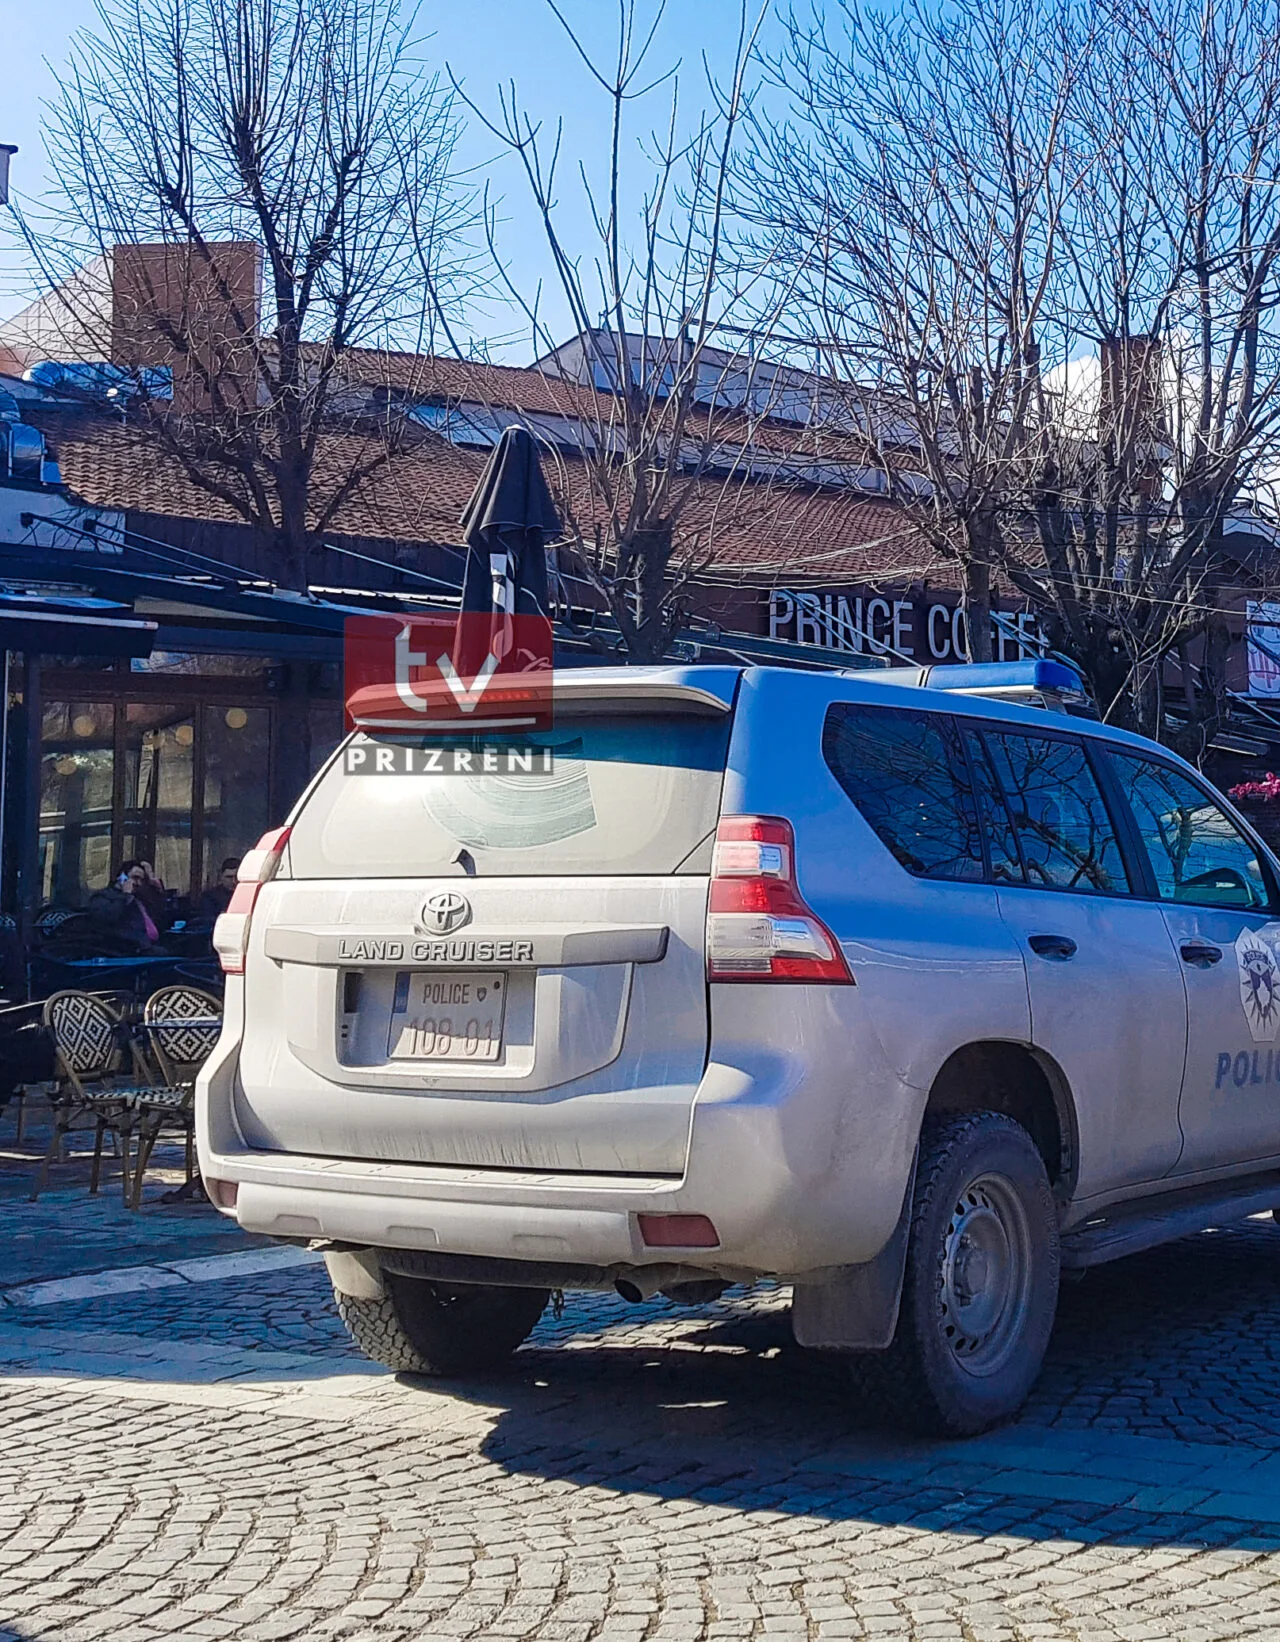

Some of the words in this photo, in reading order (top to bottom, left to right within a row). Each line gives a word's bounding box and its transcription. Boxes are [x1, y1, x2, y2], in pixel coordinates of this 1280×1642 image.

[769, 590, 914, 656] PRINCE
[338, 940, 404, 961] LAND
[411, 940, 535, 962] CRUISER
[422, 983, 470, 1005] POLICE
